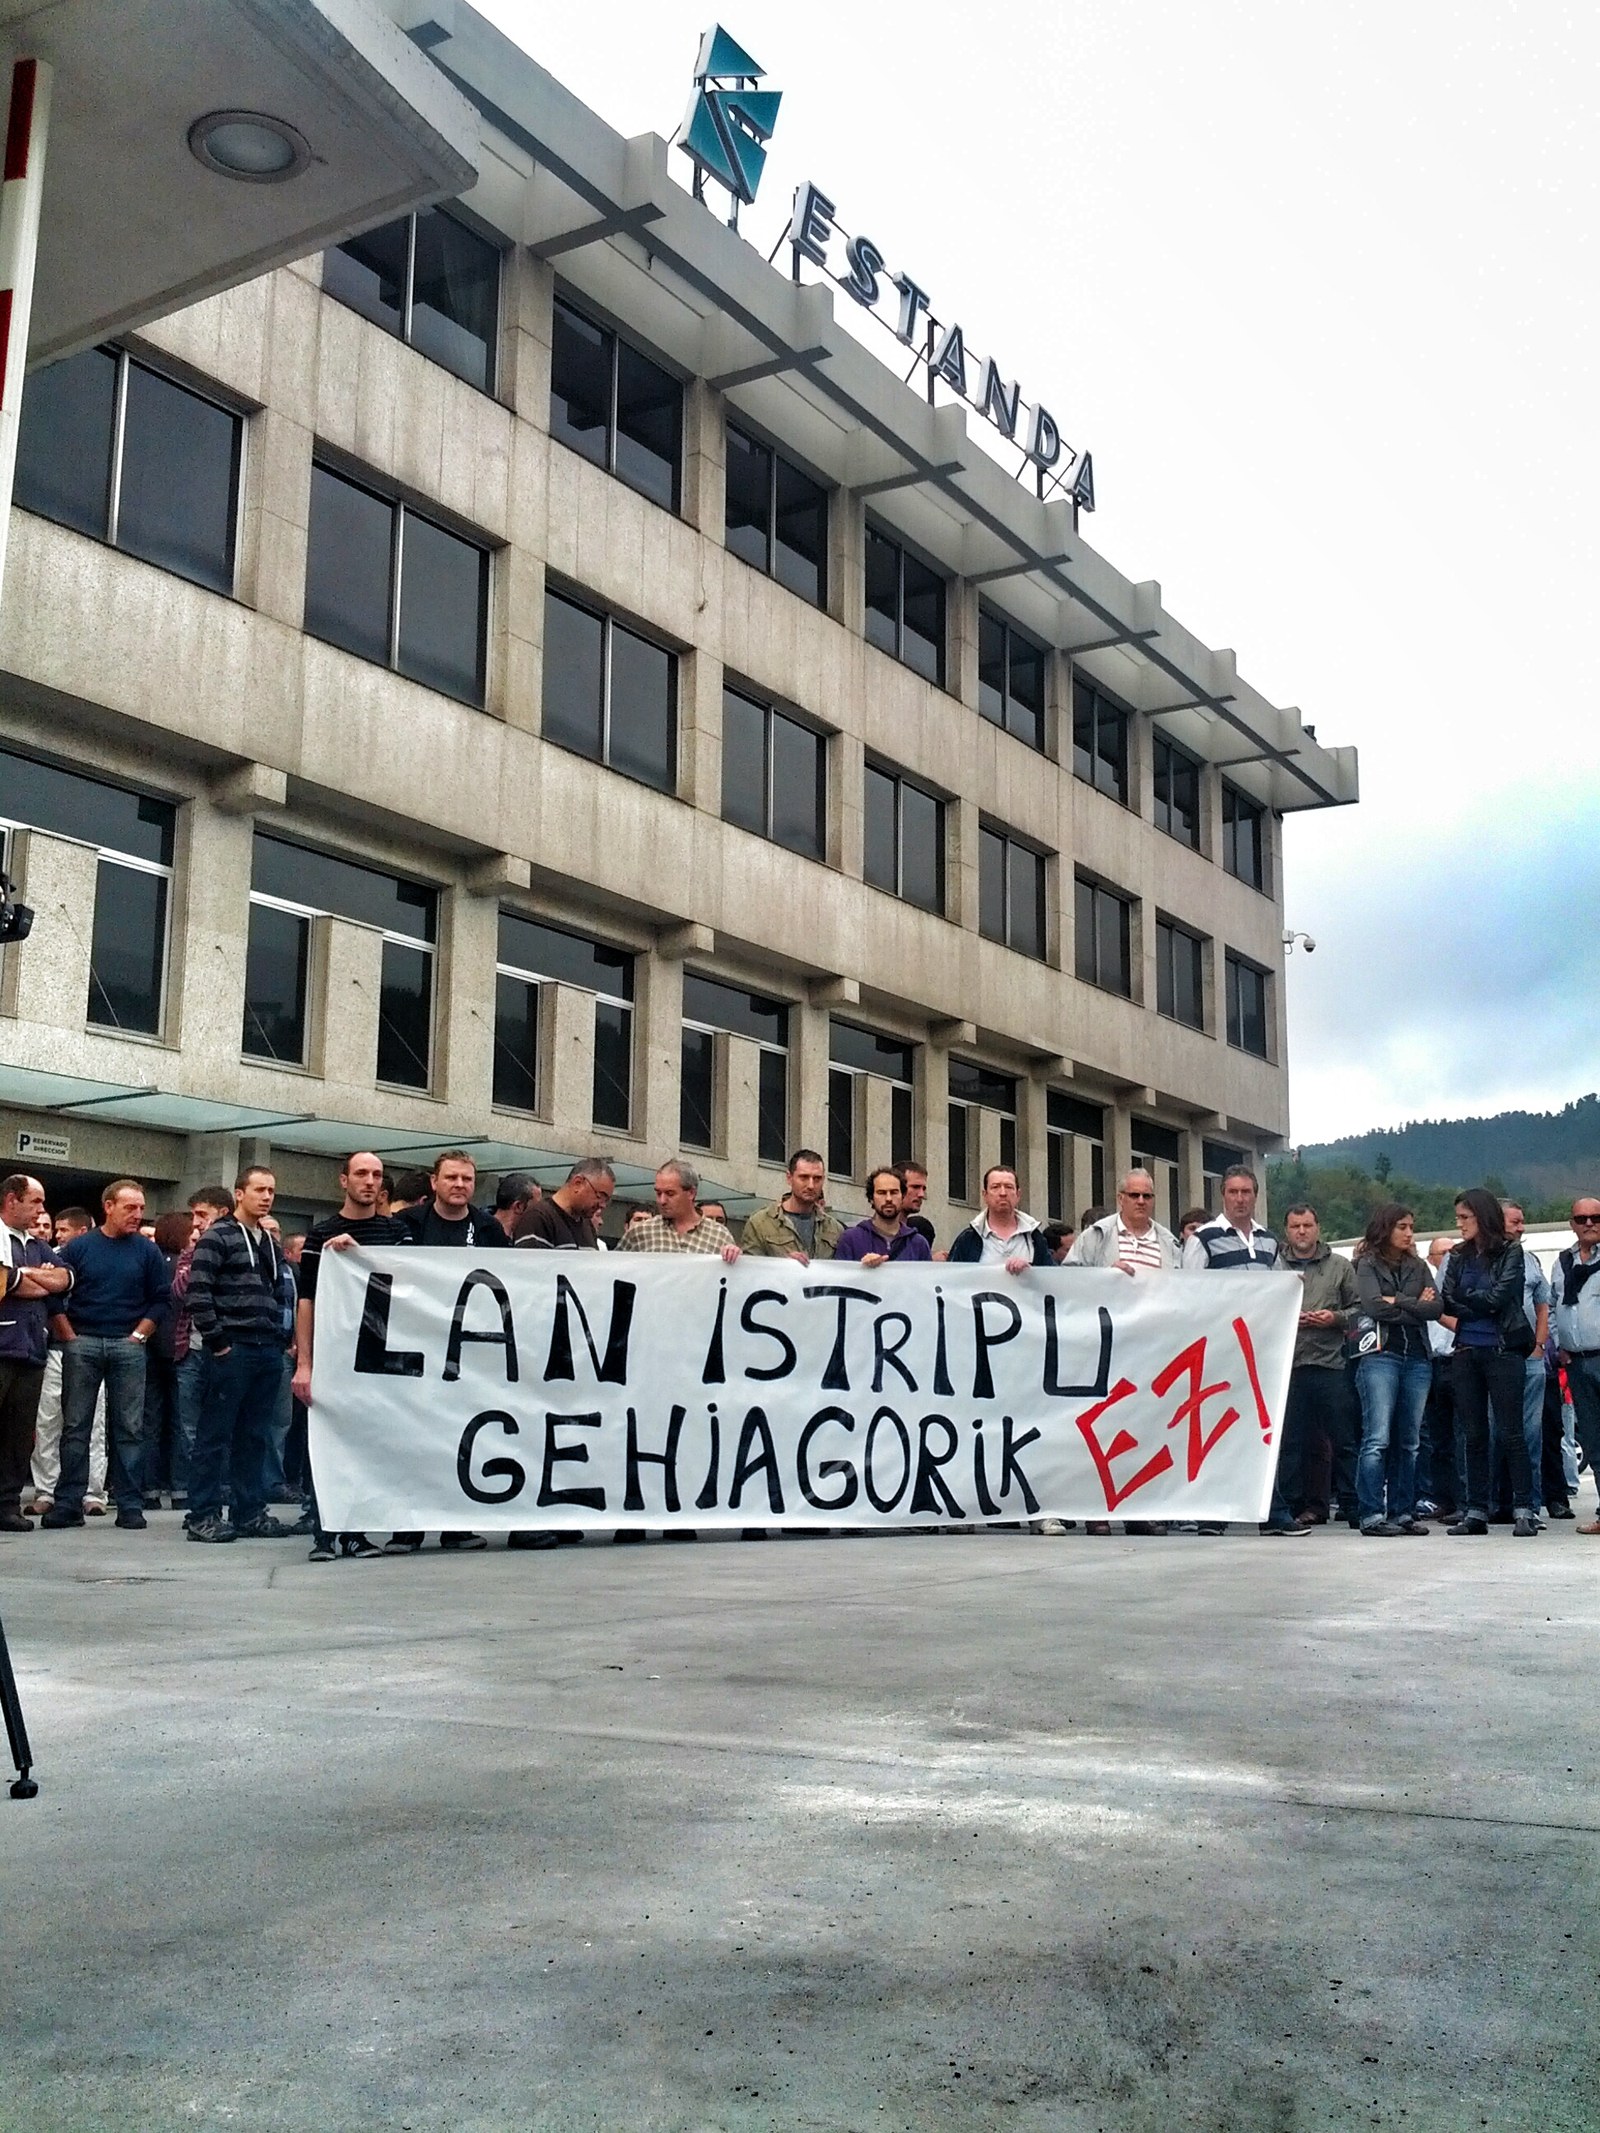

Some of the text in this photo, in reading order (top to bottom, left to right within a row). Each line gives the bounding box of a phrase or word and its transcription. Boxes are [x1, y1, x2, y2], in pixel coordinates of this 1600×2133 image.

[789, 180, 1096, 512] ESTANDA
[20, 1134, 31, 1152] P
[33, 1138, 68, 1148] RESERVADO
[354, 1268, 637, 1386] LAN
[1075, 1316, 1273, 1512] EZ!
